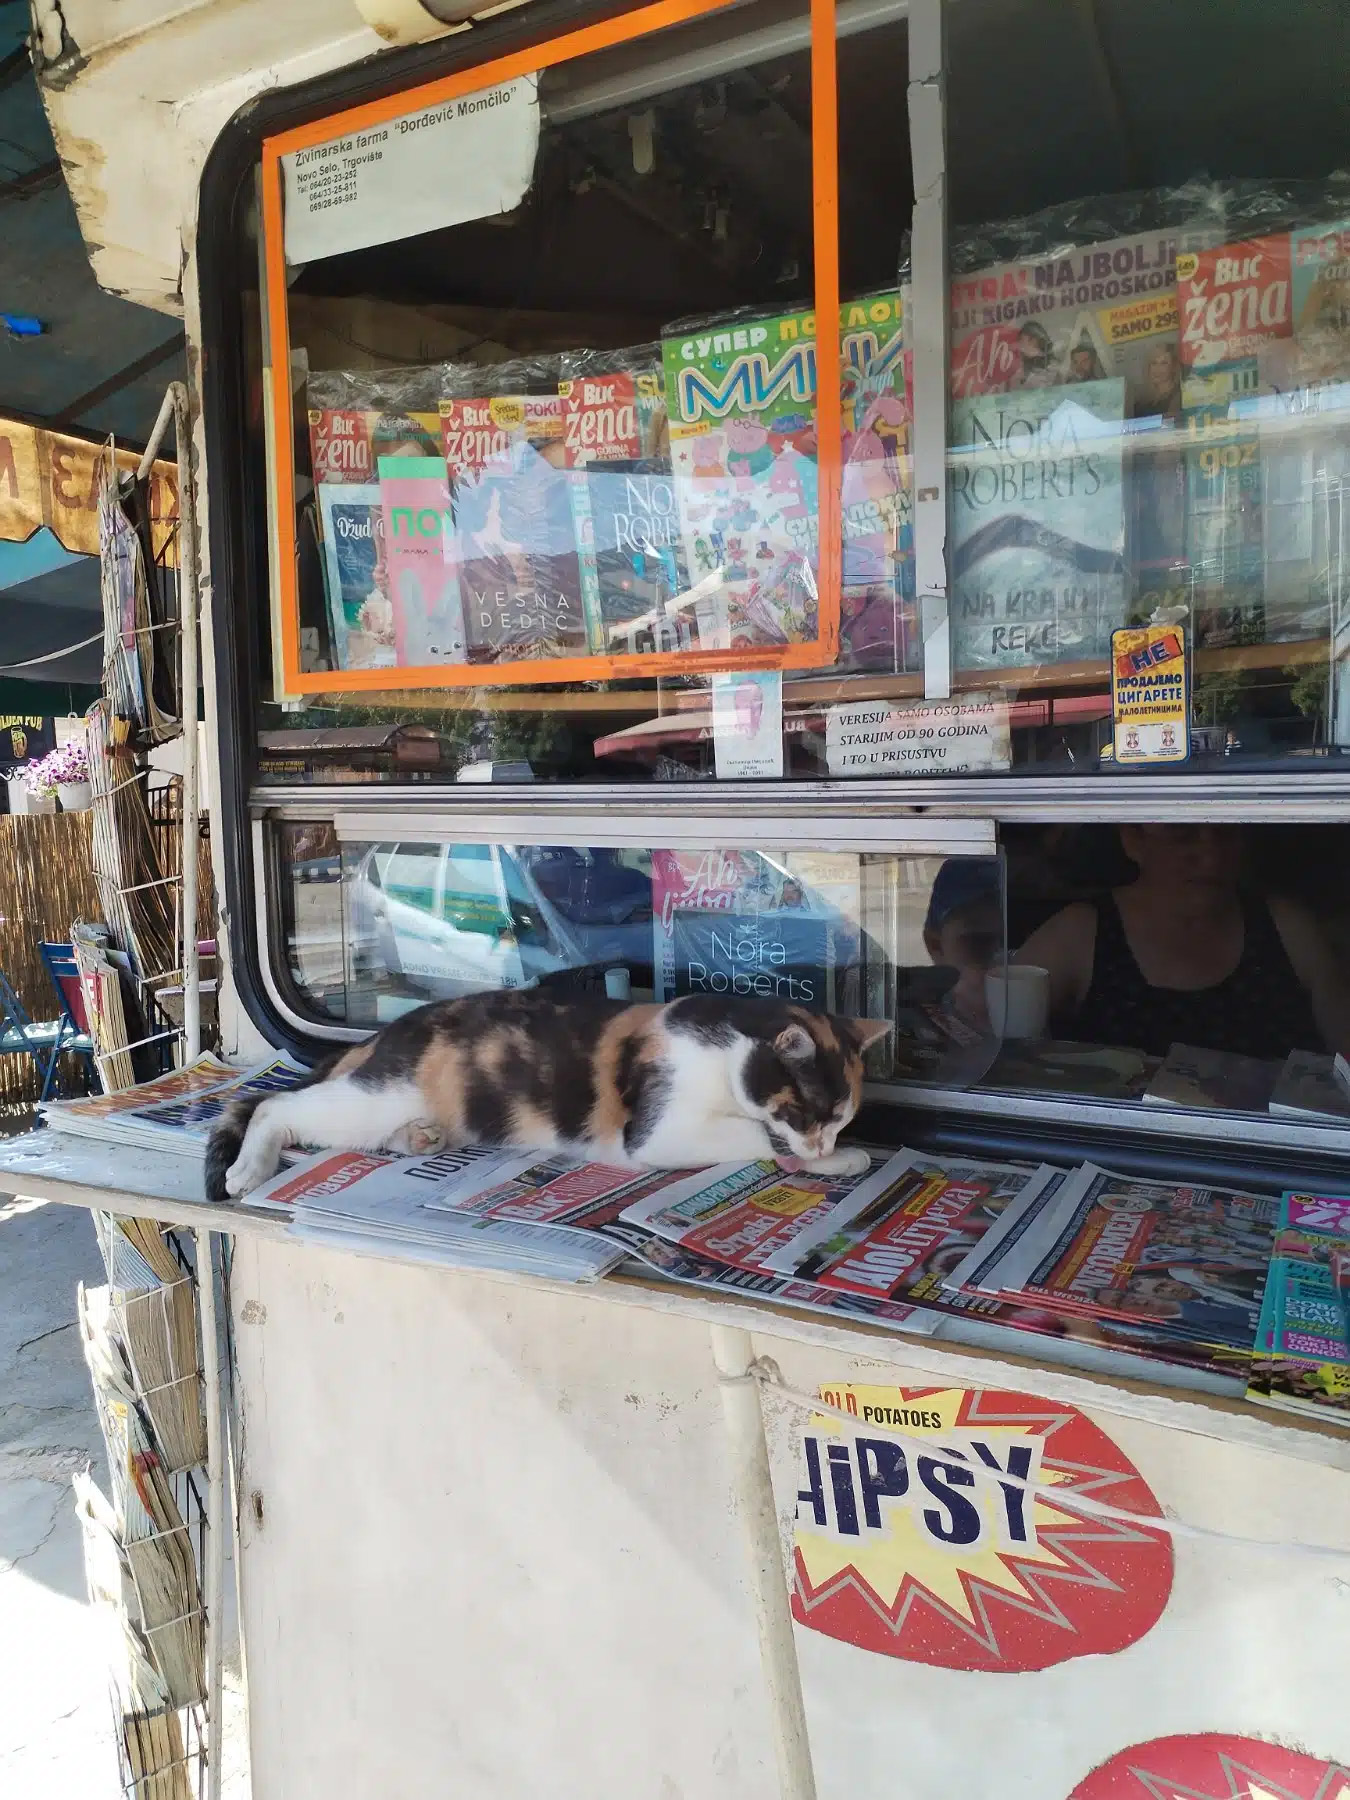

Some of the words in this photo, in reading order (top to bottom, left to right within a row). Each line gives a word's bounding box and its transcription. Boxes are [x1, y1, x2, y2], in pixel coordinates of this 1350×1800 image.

[295, 140, 353, 167] Živinarska
[356, 128, 388, 150] farma
[297, 170, 317, 184] Novo
[319, 163, 341, 177] Selo,
[342, 151, 383, 169] Trgovište
[1034, 239, 1176, 289] NAJBOLJI
[1214, 254, 1264, 287] BLIC
[1060, 269, 1177, 307] HOROSKOP
[1111, 318, 1152, 337] SAMO
[680, 327, 768, 361] СУПЕР
[584, 383, 615, 406] BLIC
[332, 415, 355, 435] BLIC
[463, 406, 490, 427] BLIC
[972, 408, 1081, 461] NORA
[950, 454, 1101, 511] ROBERTS
[475, 591, 570, 609] VESNA
[480, 609, 568, 631] DEDIĆ
[1130, 641, 1171, 673] НЕ
[1117, 673, 1183, 688] ПРОДАЈЕМО
[1118, 687, 1183, 704] ЦИГАРЕТЕ
[839, 711, 892, 727] VERESIJA
[897, 707, 930, 720] SAMO
[934, 703, 995, 717] OSOBAMA
[1118, 704, 1183, 717] МАЛОЛЕТНИЦИМА
[840, 731, 894, 747] STARIJIM
[898, 730, 916, 740] OD
[919, 728, 934, 739] 90
[938, 725, 988, 738] GODINA
[849, 754, 867, 765] TO
[870, 752, 878, 763] U
[882, 748, 947, 762] PRISUSTVU
[711, 931, 786, 965] Nora
[688, 962, 814, 1001] Roberts
[818, 1390, 858, 1417] OLD
[863, 1405, 942, 1430] POTATOES
